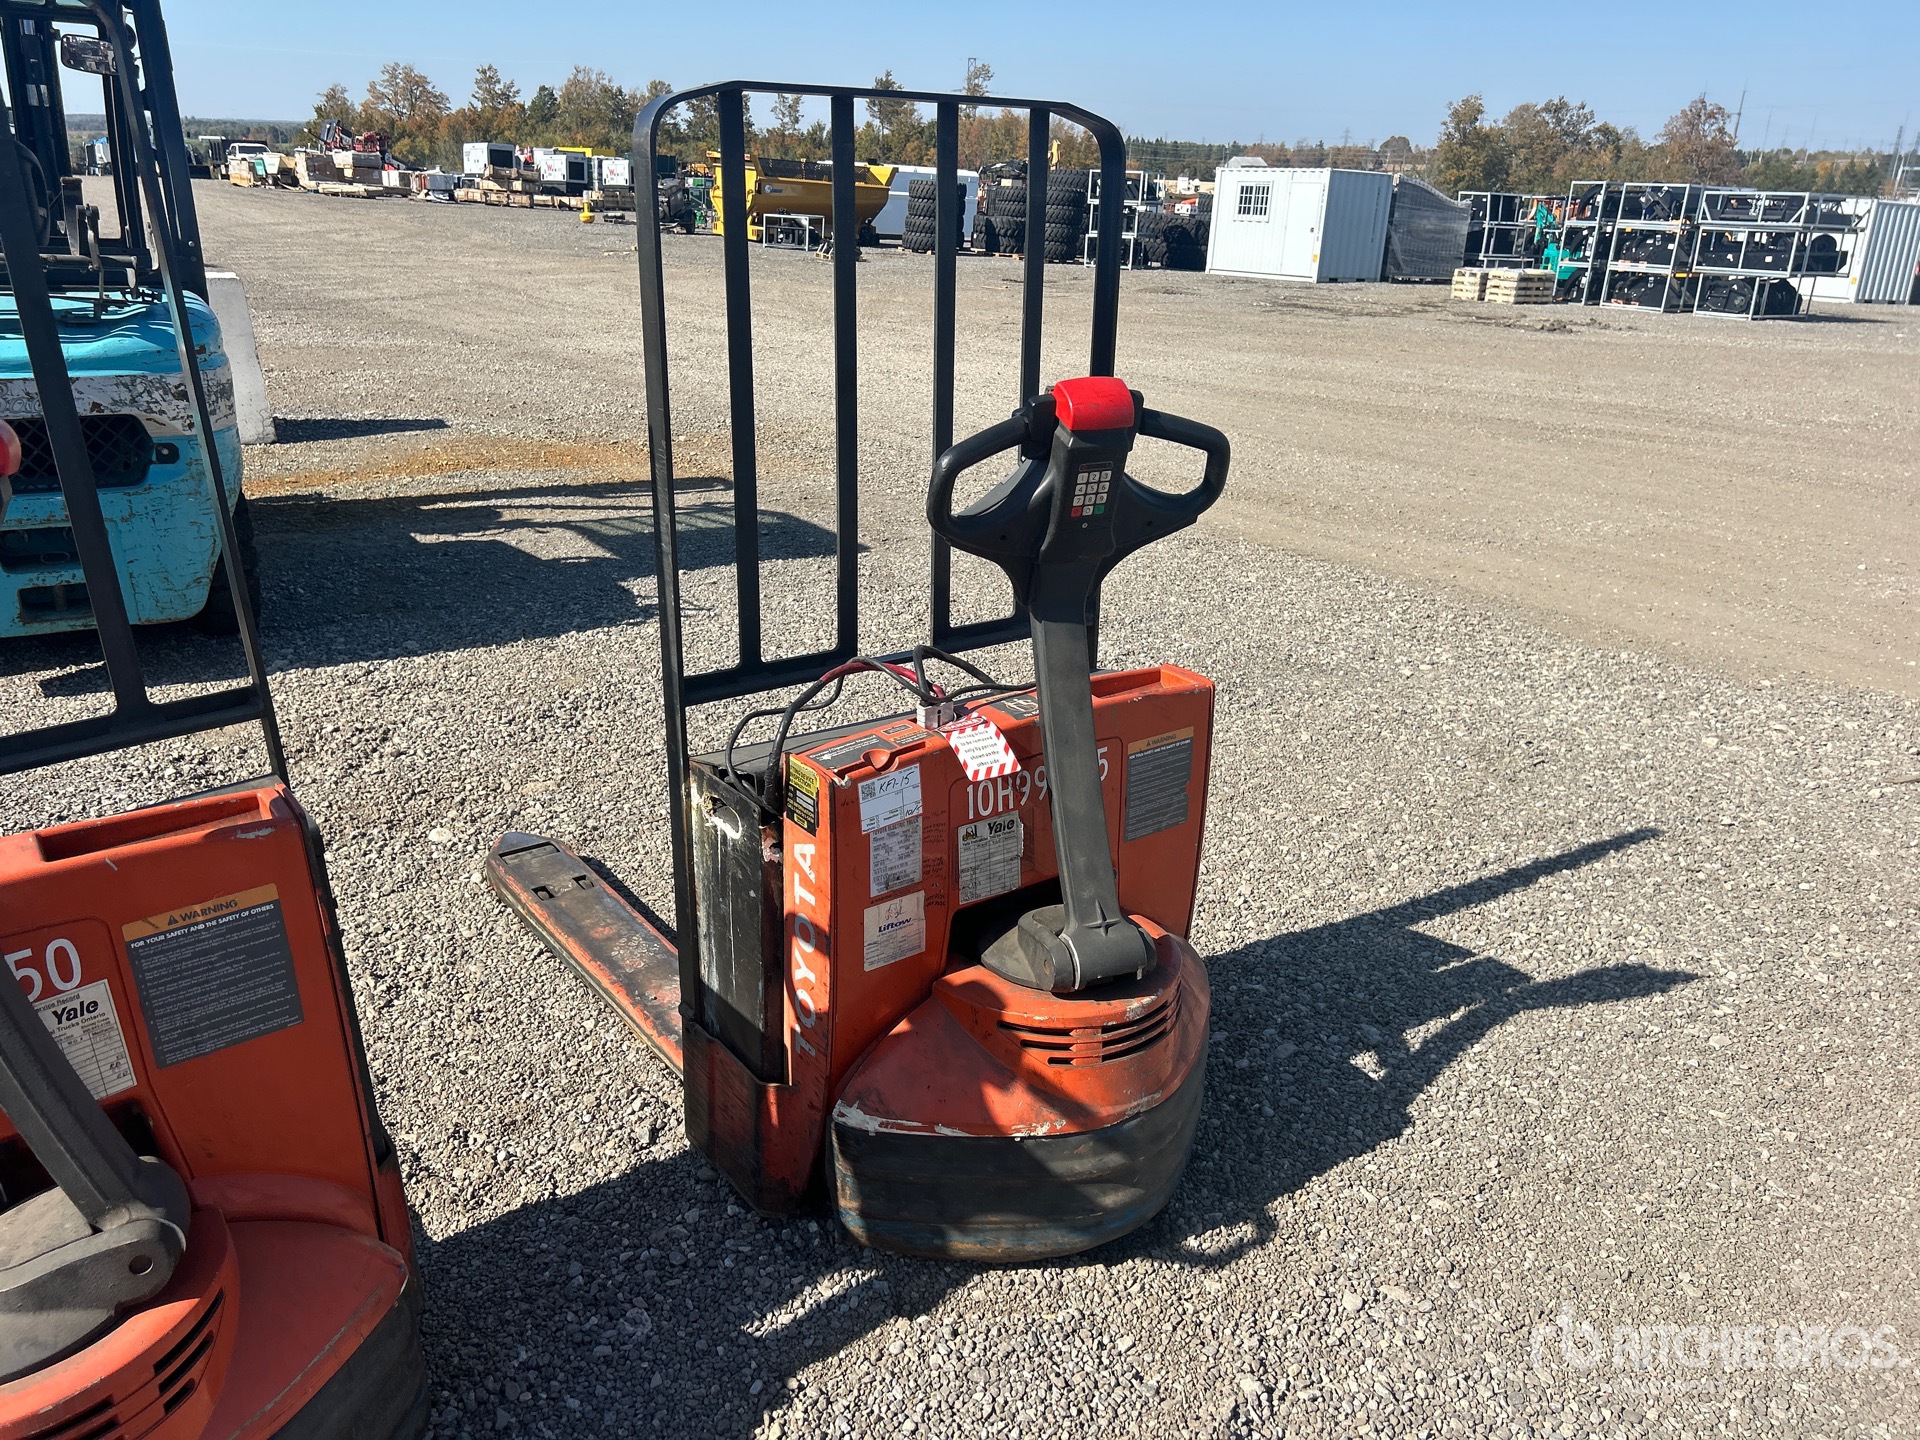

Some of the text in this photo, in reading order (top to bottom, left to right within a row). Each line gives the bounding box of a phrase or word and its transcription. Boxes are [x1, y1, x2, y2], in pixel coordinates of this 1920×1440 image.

[987, 819, 1015, 836] Yale
[180, 899, 239, 922] WARNING
[130, 903, 275, 949] FOR YOUR SAFETY AND THE SAFETY OF OTHERS
[793, 843, 816, 1058] TOYOTA
[51, 999, 99, 1026] Yale
[56, 1020, 80, 1033] Trucks
[80, 1011, 106, 1023] Ontario
